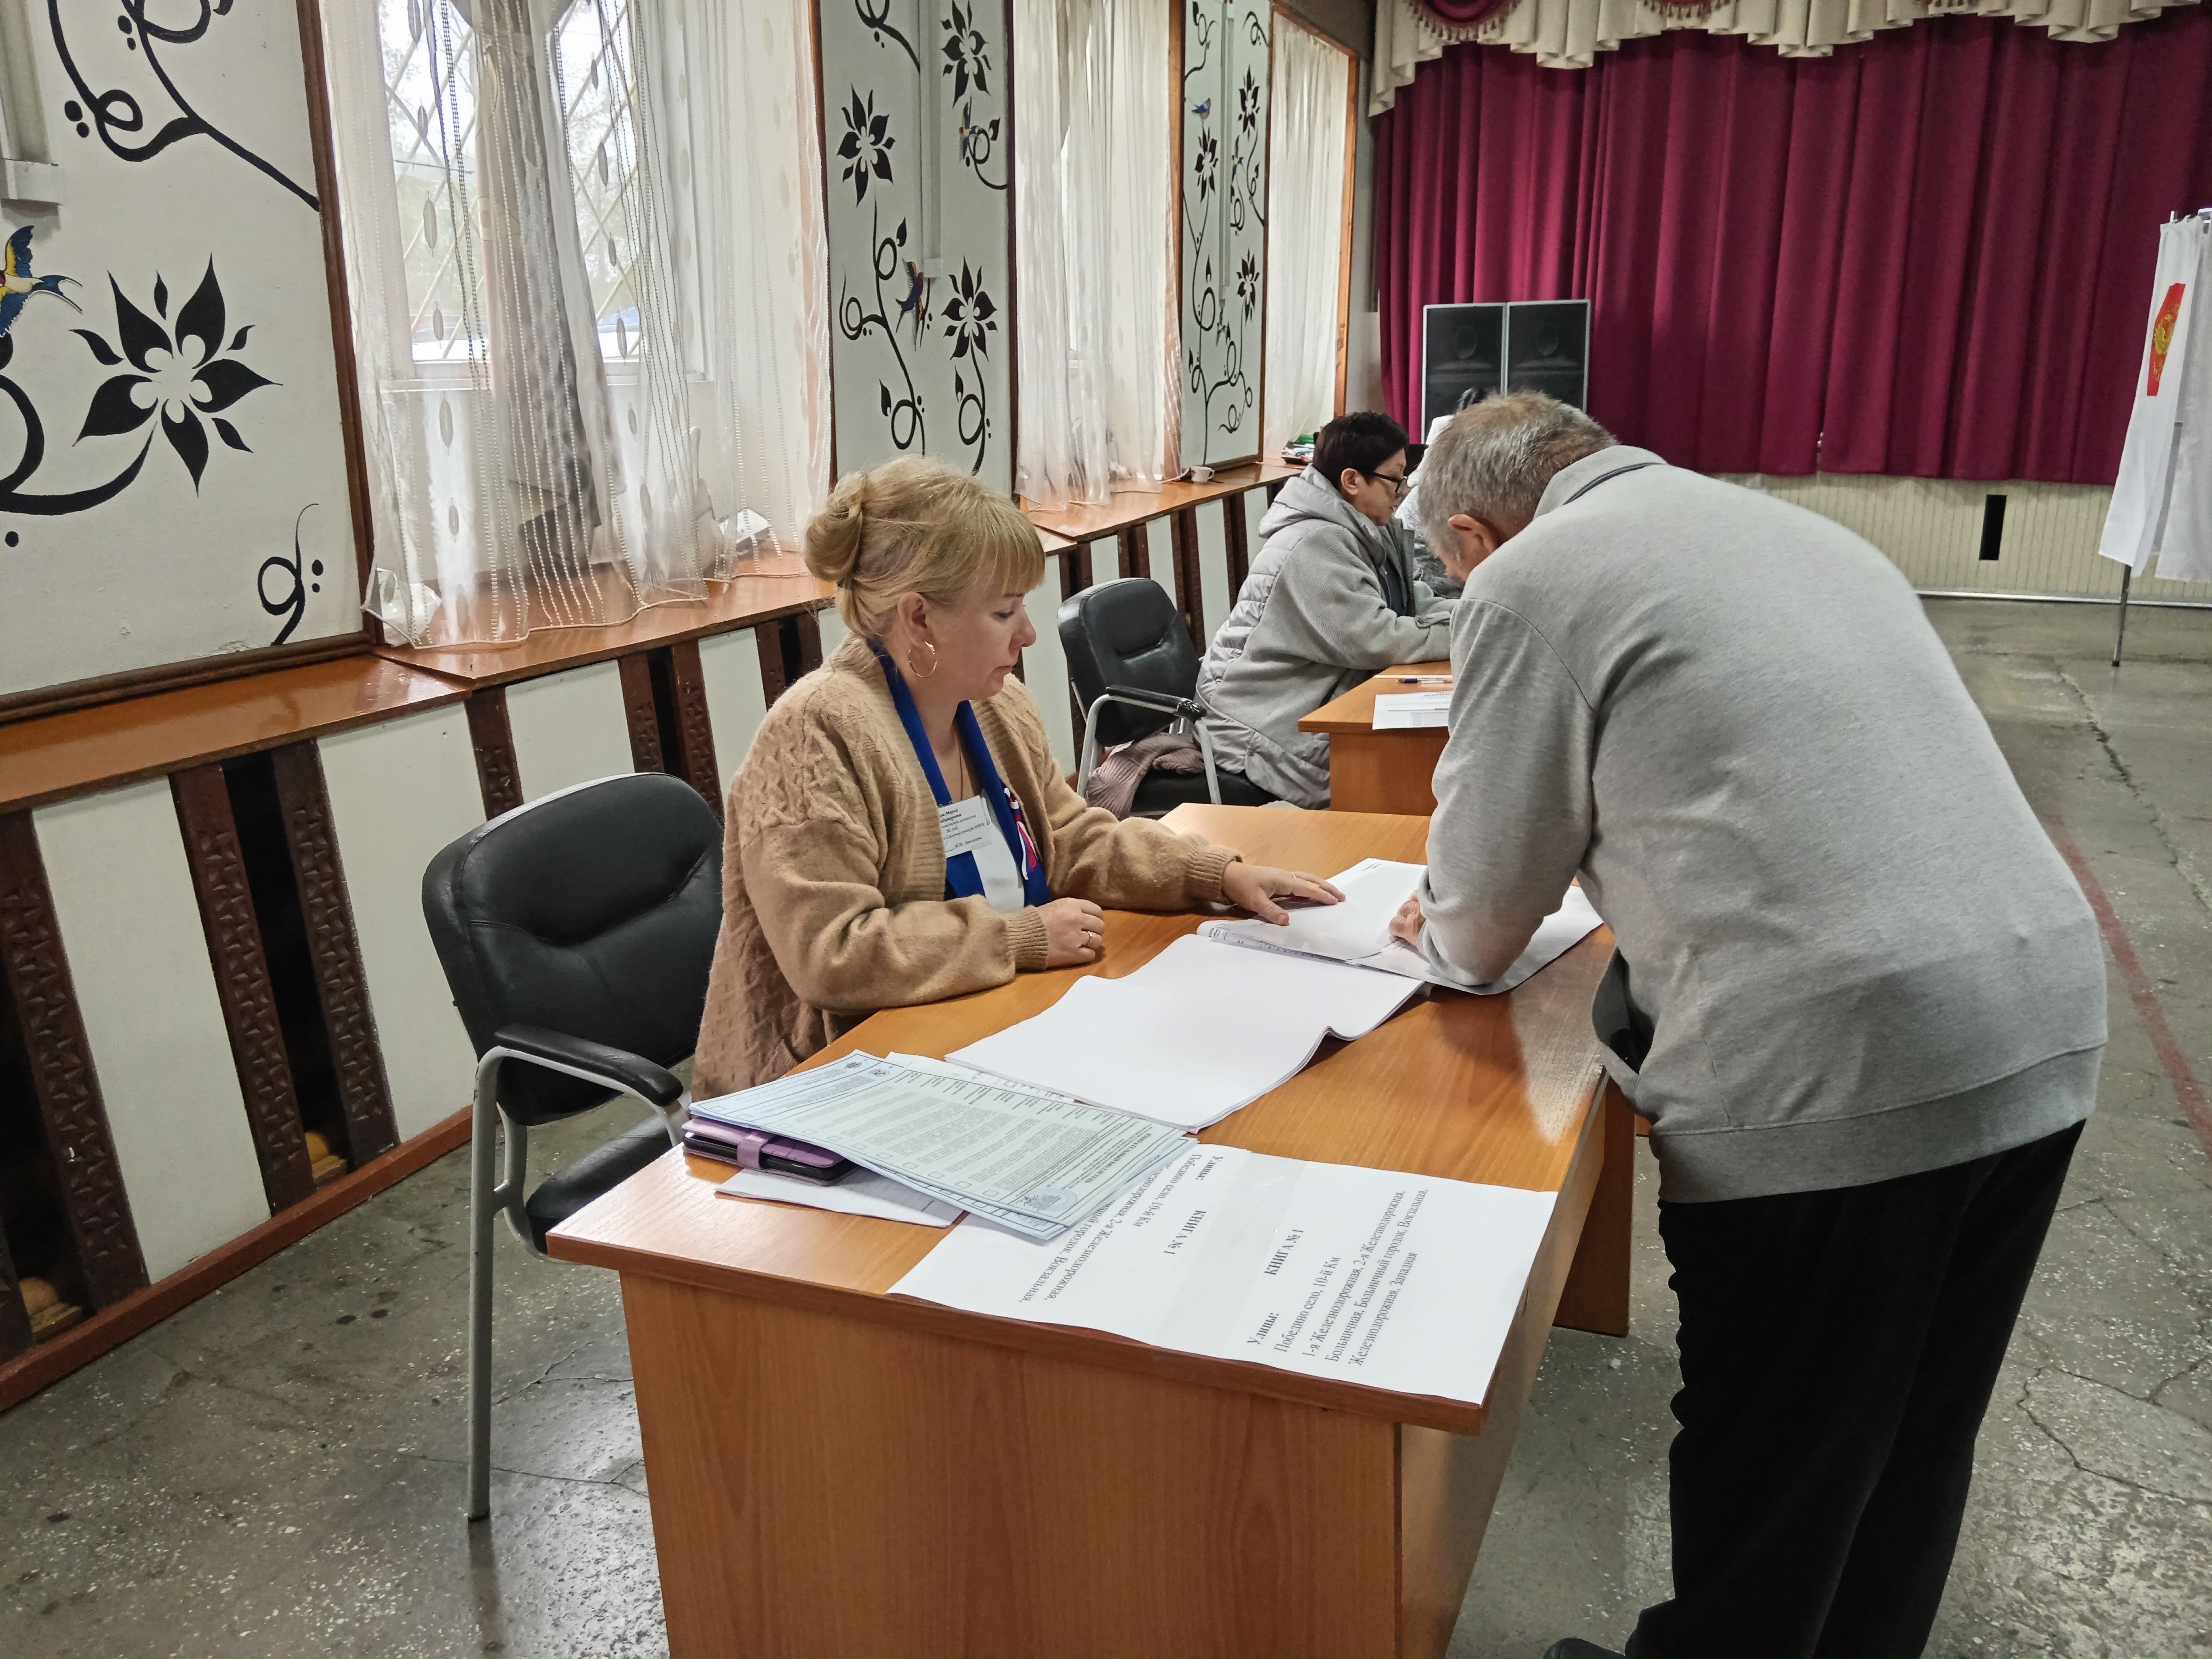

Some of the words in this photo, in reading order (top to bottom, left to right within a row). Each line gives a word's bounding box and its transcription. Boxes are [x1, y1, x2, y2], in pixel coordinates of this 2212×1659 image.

[1170, 1154, 1202, 1184] Победино
[1195, 1156, 1224, 1180] Улицы:
[1155, 1184, 1174, 1200] село,
[1133, 1216, 1151, 1227] Км
[1143, 1202, 1163, 1216] 10-й
[1360, 1191, 1407, 1253] Железнодорожная,
[1104, 1218, 1122, 1229] 2-я
[1175, 1210, 1206, 1238] КНИГА
[1059, 1224, 1091, 1254] городок,
[1167, 1240, 1184, 1249] №
[1044, 1229, 1113, 1300] Железнодорожная,
[1264, 1245, 1294, 1276] КНИГА
[1285, 1234, 1300, 1243] №
[1323, 1257, 1340, 1269] Км
[1353, 1254, 1370, 1266] 2-я
[1019, 1256, 1068, 1303] Вокзальная,
[1313, 1270, 1333, 1287] 10-й
[1324, 1310, 1366, 1362] Больничная,
[1353, 1260, 1390, 1308] Больничный
[1383, 1230, 1407, 1259] городок,
[1397, 1189, 1429, 1227] Вокзальная,
[1303, 1290, 1324, 1310] село,
[1310, 1268, 1364, 1342] Железнодорожная,
[1348, 1289, 1401, 1366] Железнодорожная,
[1389, 1252, 1418, 1286] Западная
[1246, 1312, 1279, 1345] Улицы:
[1273, 1311, 1309, 1352] Победино
[1302, 1344, 1321, 1357] 1-я
